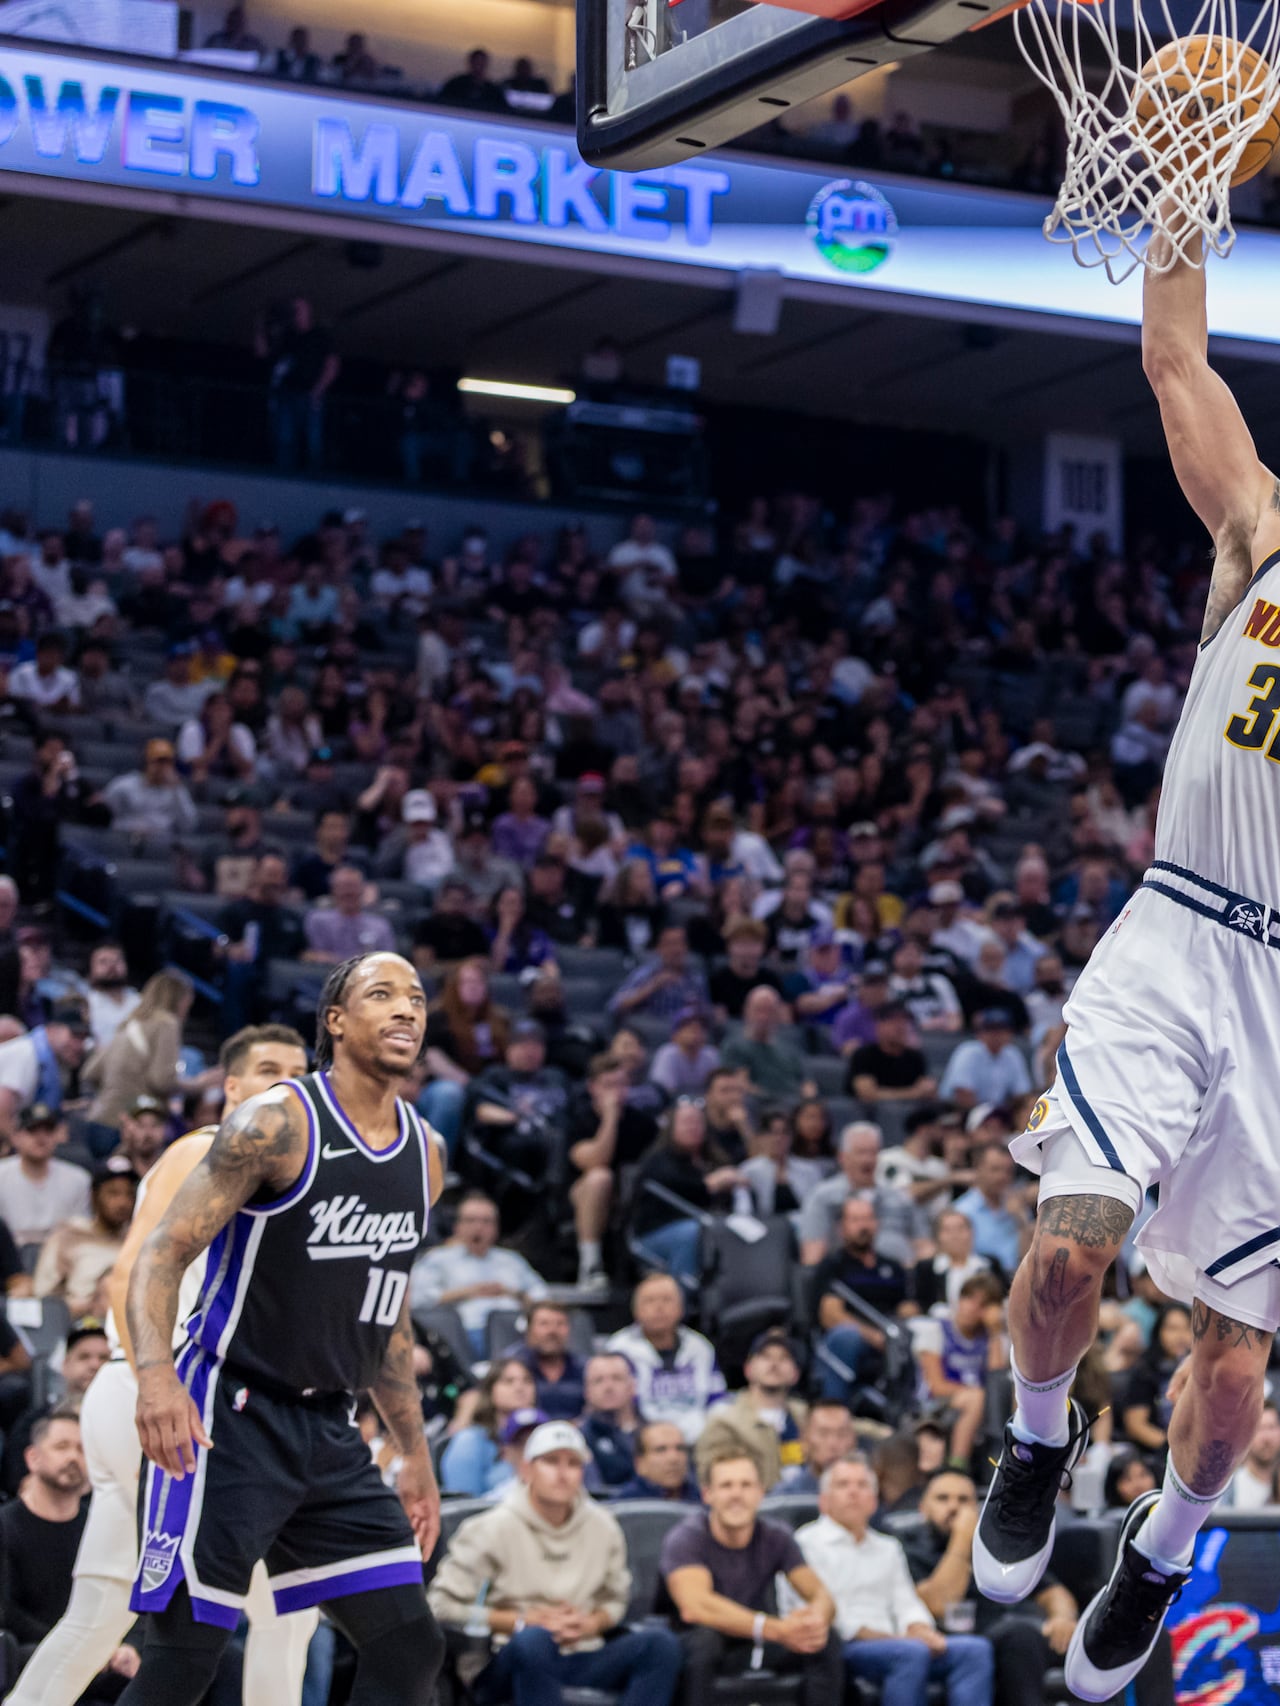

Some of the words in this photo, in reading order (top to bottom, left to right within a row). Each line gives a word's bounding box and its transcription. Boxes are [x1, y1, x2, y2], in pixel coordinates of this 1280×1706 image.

[312, 117, 732, 247] MARKET
[306, 1195, 420, 1262] Kings
[358, 1266, 409, 1326] 10
